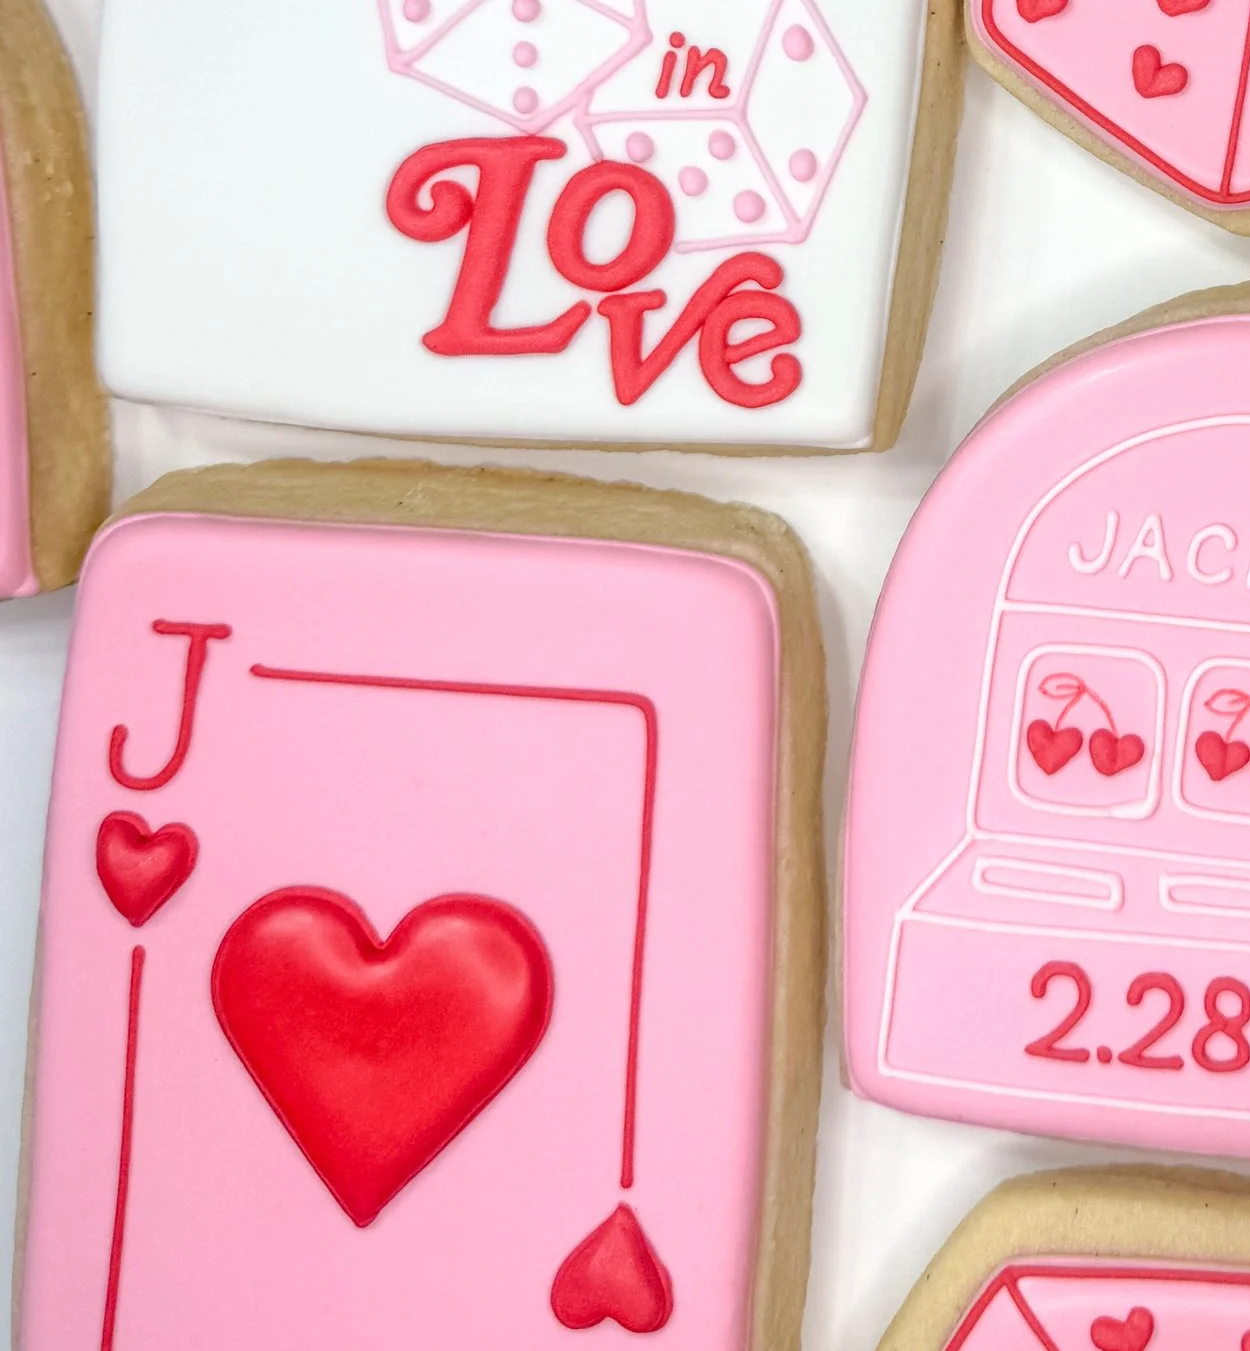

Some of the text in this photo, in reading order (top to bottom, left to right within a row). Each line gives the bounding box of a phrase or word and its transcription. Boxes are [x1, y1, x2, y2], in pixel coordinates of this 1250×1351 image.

[655, 31, 730, 100] in
[386, 133, 803, 409] Love
[107, 618, 233, 793] J
